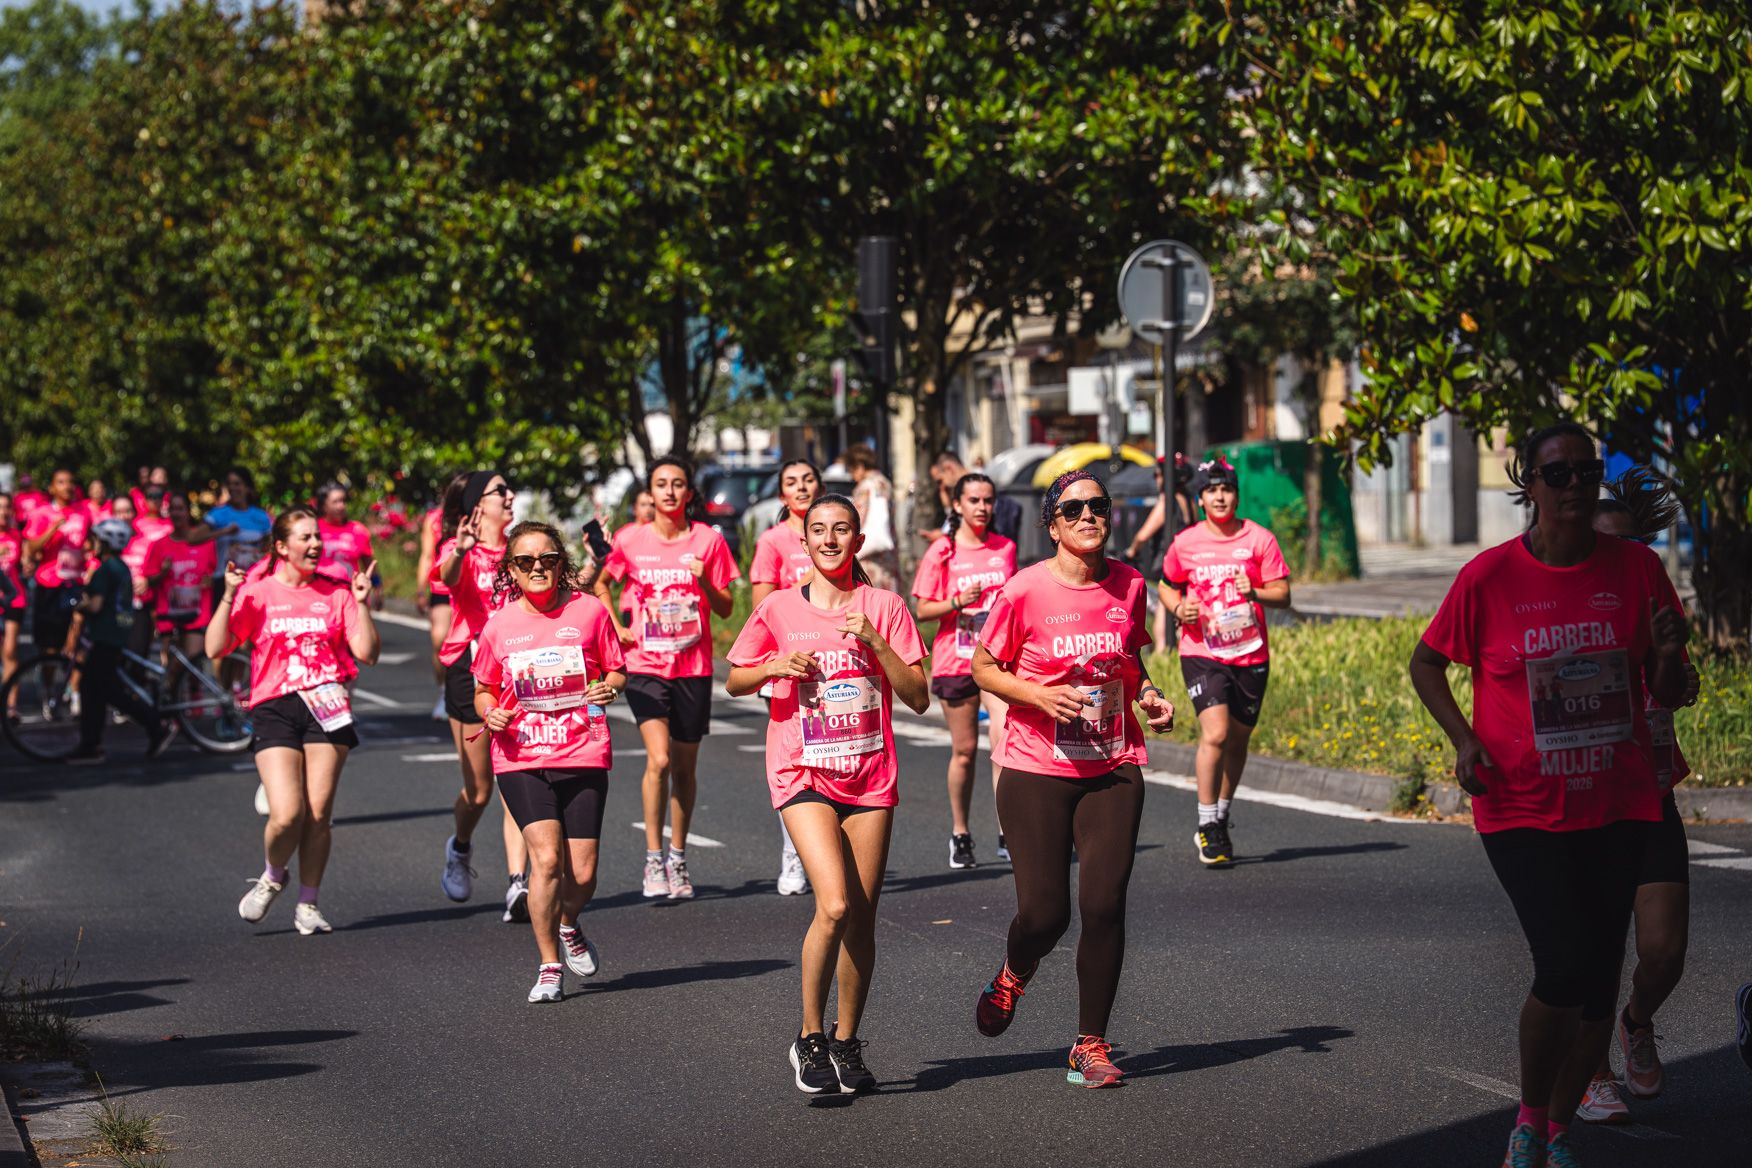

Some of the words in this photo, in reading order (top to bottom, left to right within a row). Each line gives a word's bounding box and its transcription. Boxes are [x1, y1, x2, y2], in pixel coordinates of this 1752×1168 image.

[1515, 600, 1557, 614] OYSHO
[1045, 612, 1081, 625] OYSHO
[270, 617, 328, 634] CARRERA
[787, 631, 821, 642] OYSHO
[1524, 621, 1617, 654] CARRERA
[1053, 631, 1124, 658] CARRERA
[537, 676, 564, 689] 016
[826, 689, 859, 700] ASTURIANA
[1564, 694, 1601, 713] 016
[828, 713, 860, 729] 016
[1546, 734, 1578, 746] OYSHO
[813, 745, 840, 755] OYSHO
[1064, 748, 1090, 757] OYSHO
[1540, 745, 1615, 776] MUJER
